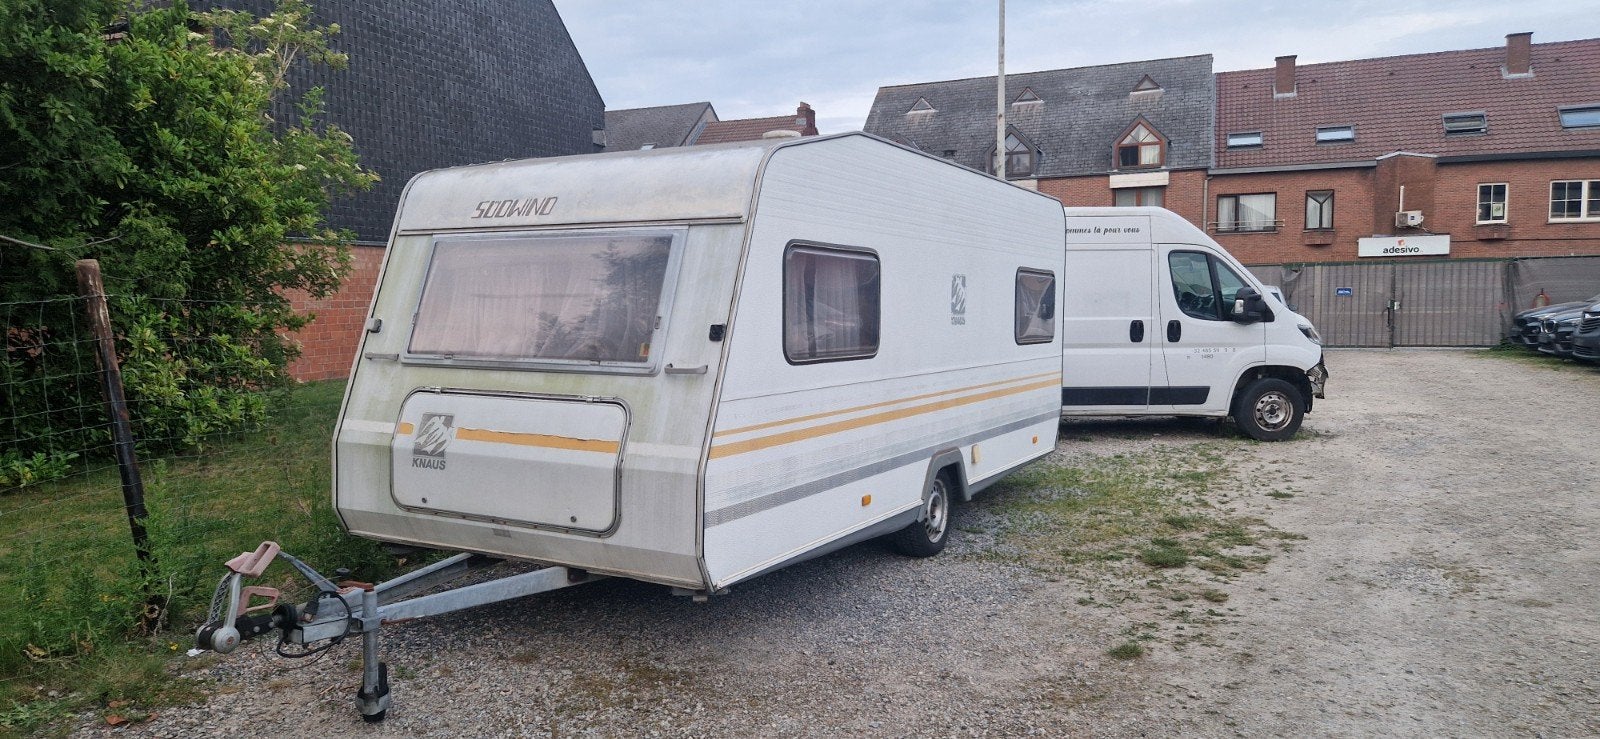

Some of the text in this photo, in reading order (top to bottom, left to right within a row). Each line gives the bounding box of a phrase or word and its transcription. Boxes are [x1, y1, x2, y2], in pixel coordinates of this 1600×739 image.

[1103, 227, 1121, 236] pour
[1382, 246, 1420, 254] adesivo
[411, 457, 447, 471] KNAUS
